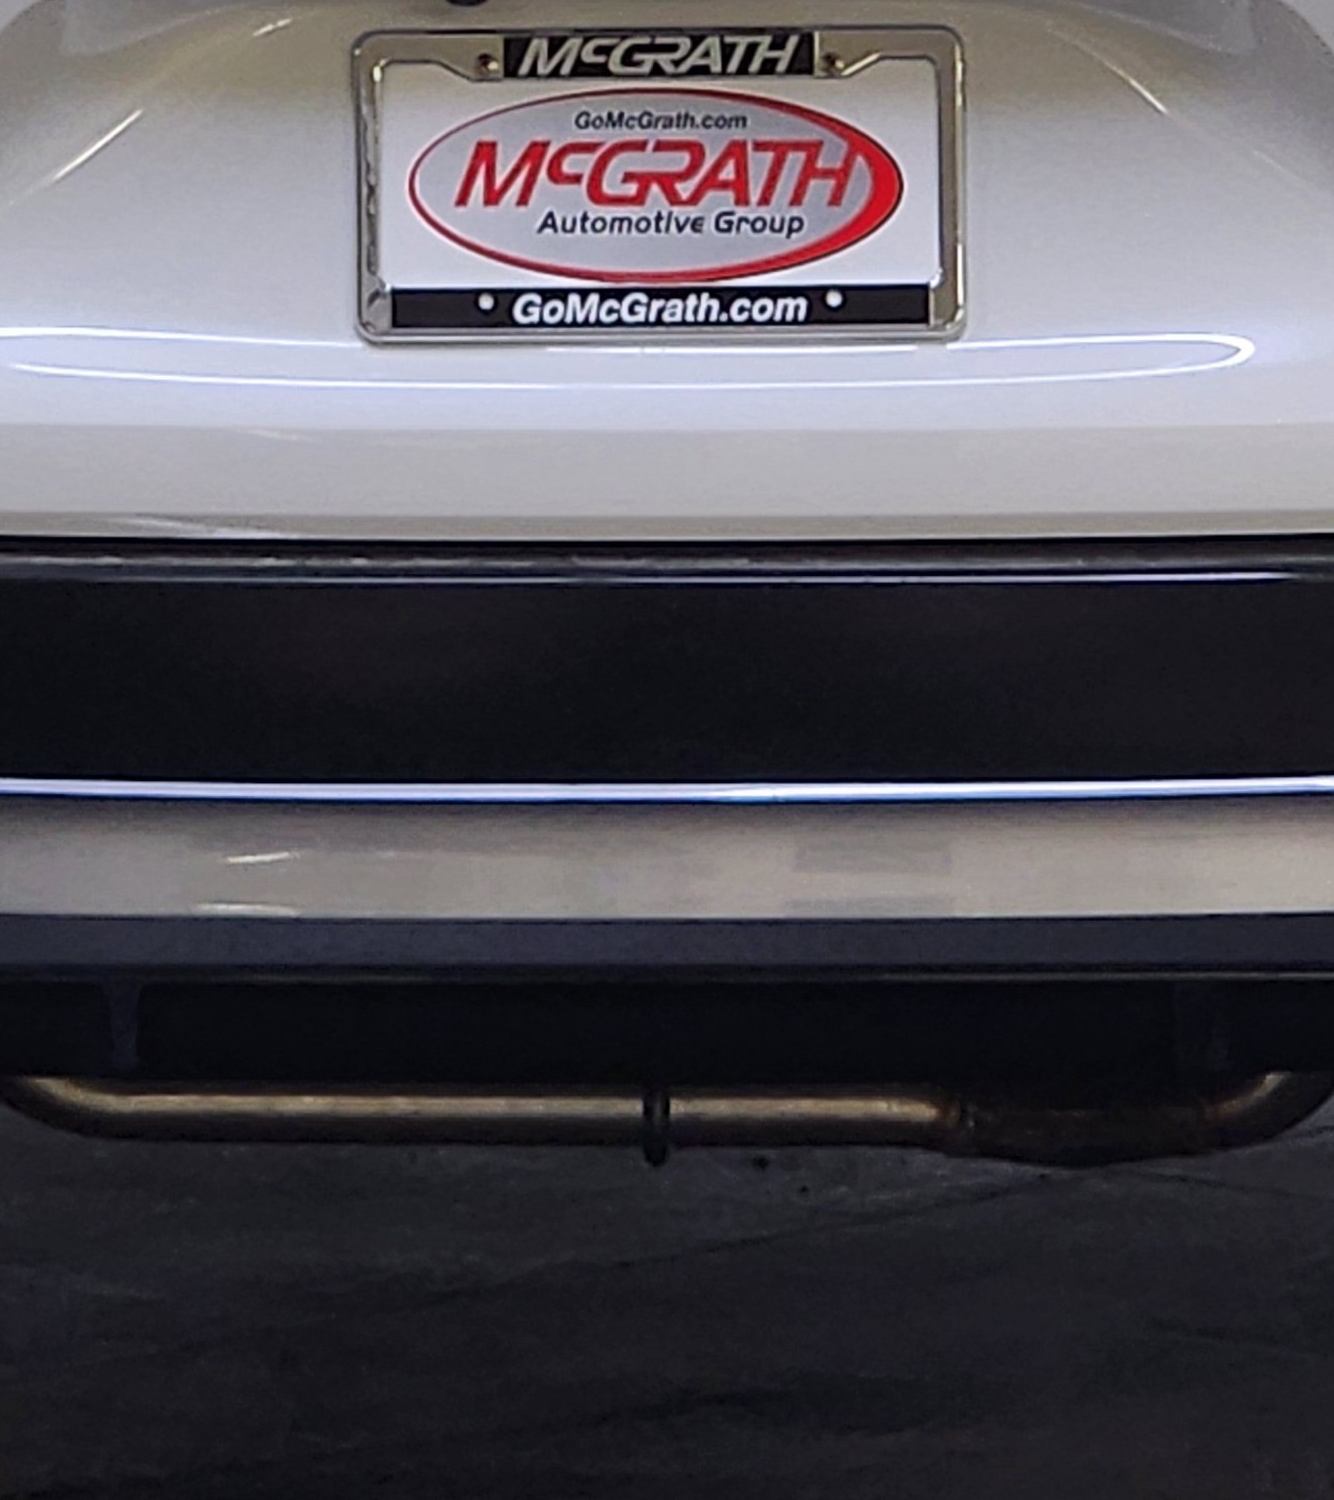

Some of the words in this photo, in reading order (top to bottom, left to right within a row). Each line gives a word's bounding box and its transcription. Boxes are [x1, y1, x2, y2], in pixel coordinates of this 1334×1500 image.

[574, 110, 748, 131] GoMcGrath.com
[537, 210, 703, 236] Automotive
[714, 211, 805, 240] Group
[512, 295, 808, 326] GoMcGrath.com
